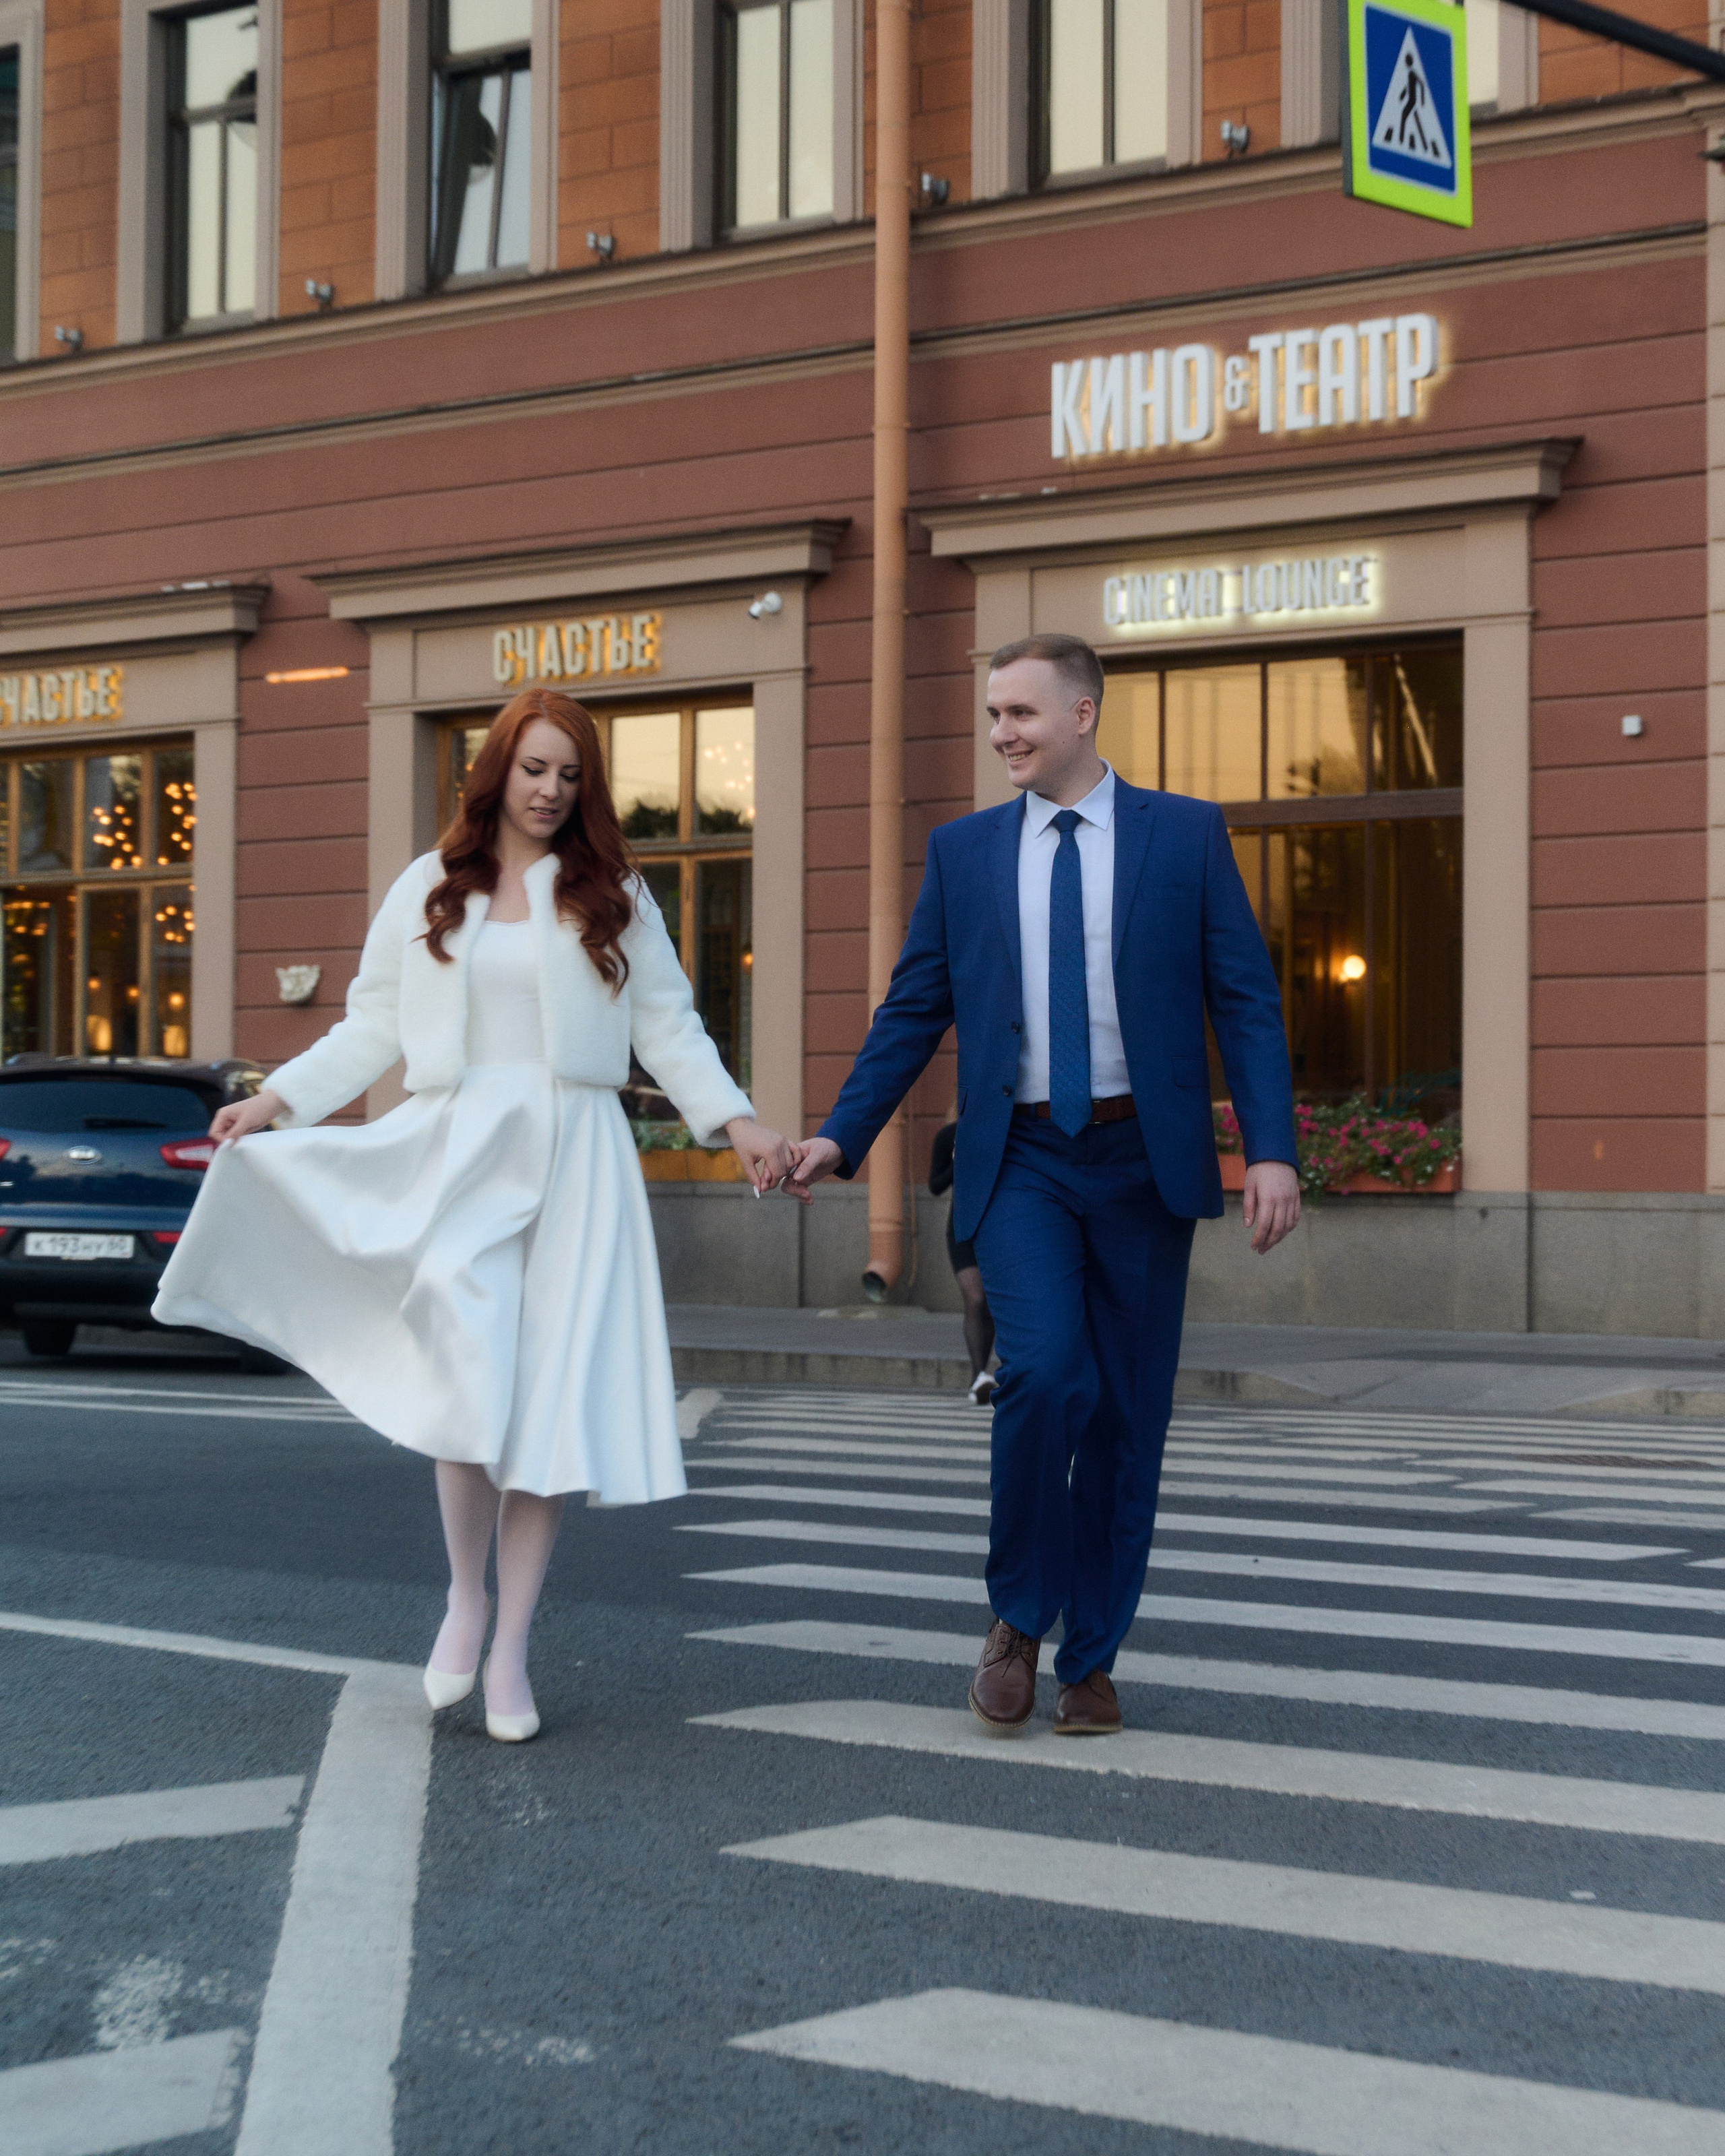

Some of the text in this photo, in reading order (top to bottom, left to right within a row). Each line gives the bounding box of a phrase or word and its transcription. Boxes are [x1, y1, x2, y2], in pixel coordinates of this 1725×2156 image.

[1051, 313, 1439, 459] КИНО & ТЕАТР
[1104, 555, 1371, 625] CINEMA LOUNGE
[493, 614, 655, 683] СЧАСТЬЕ
[0, 667, 115, 726] ЧАСТЬЕ
